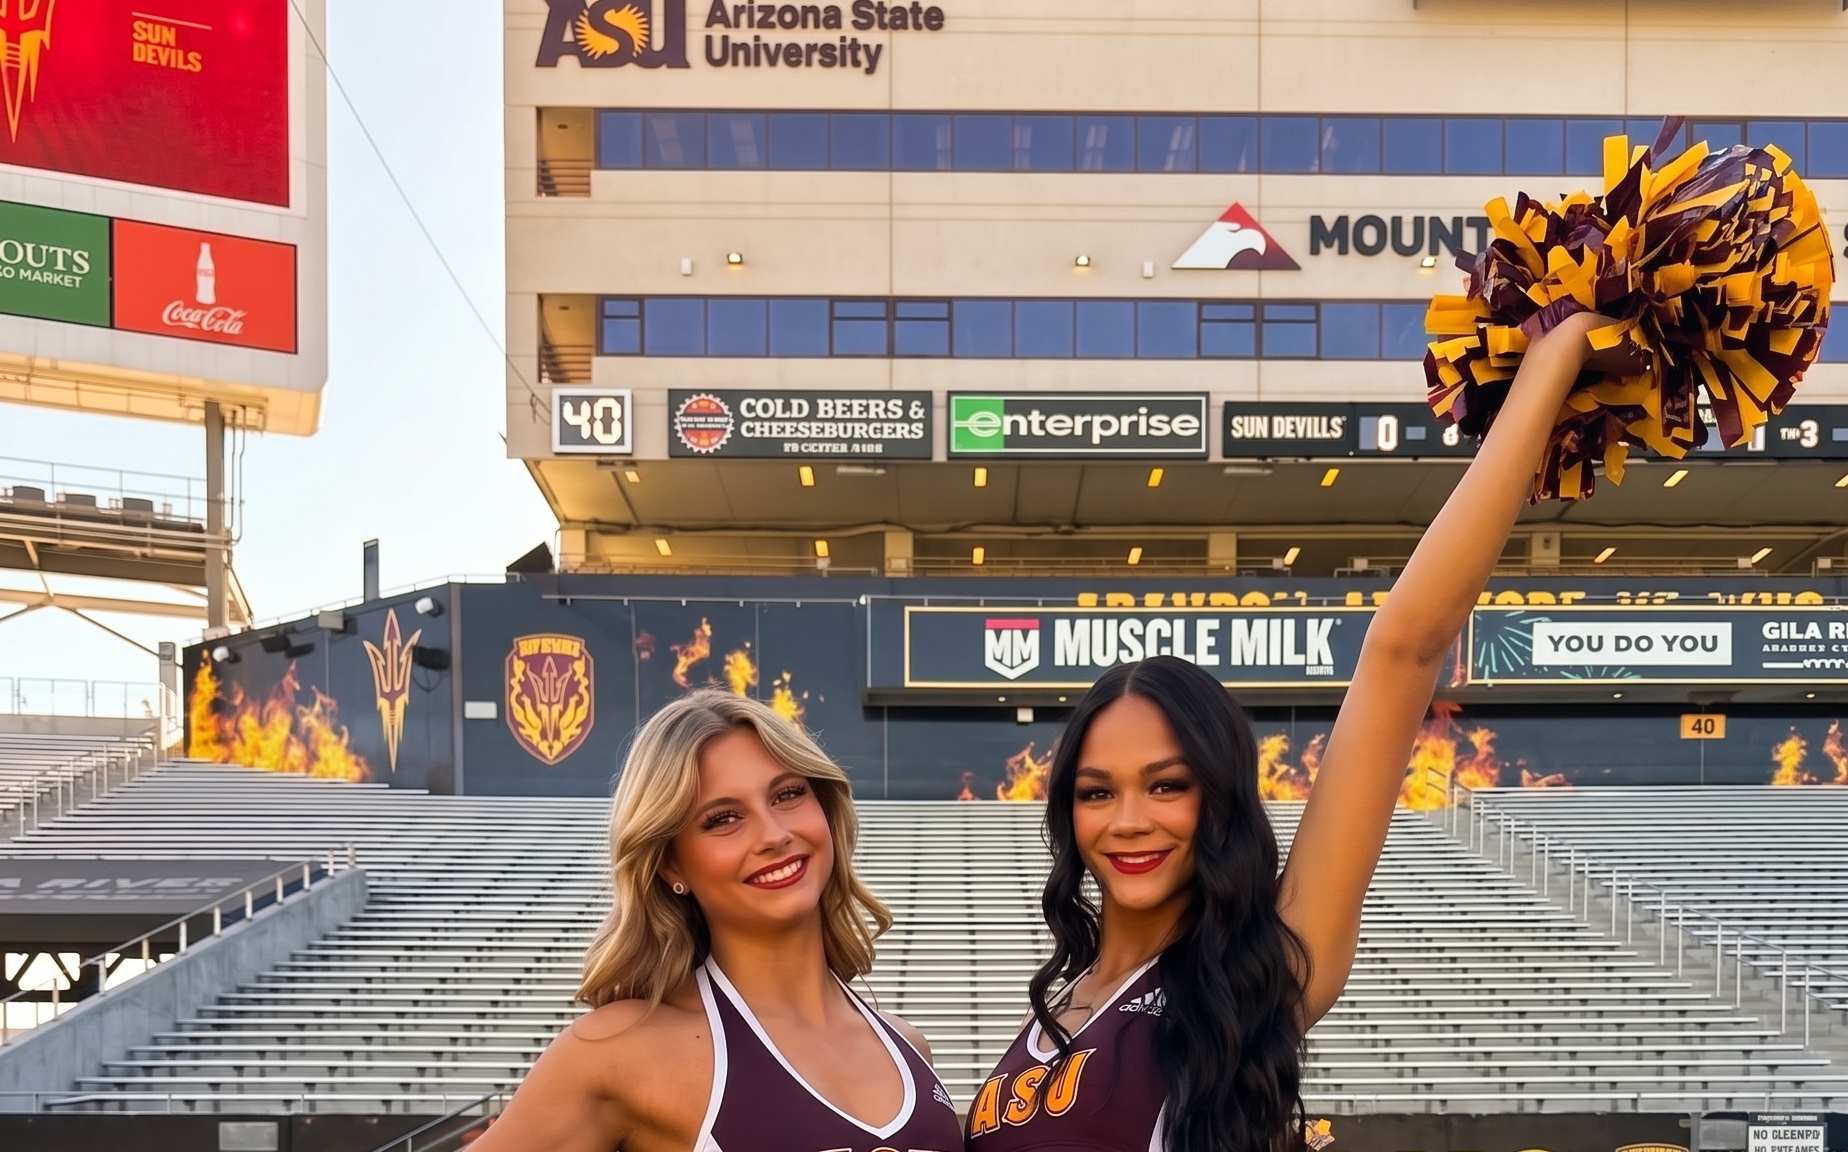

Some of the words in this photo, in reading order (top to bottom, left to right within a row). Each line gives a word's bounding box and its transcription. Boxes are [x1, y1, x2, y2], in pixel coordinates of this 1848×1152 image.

[705, 0, 842, 29] Arizona
[851, 0, 945, 31] State
[132, 20, 176, 47] SUN
[535, 0, 691, 69] ASU
[132, 43, 202, 72] DEVILS
[705, 35, 882, 74] University
[19, 268, 83, 288] MARKET
[562, 397, 622, 445] 40
[739, 398, 810, 419] COLD
[816, 398, 904, 420] BEERS
[908, 400, 926, 420] &
[740, 420, 925, 440] CHEESEBURGERS
[967, 406, 1201, 446] enterprise
[1231, 415, 1269, 439] SUN
[1054, 618, 1221, 667] MUSCLE
[1231, 618, 1335, 666] MILK
[1547, 634, 1604, 653] YOU
[1614, 634, 1655, 653] DO
[1662, 634, 1719, 653] YOU
[1761, 621, 1824, 640] GILA
[1691, 718, 1715, 735] 40
[970, 1047, 1098, 1140] ASU
[1753, 1129, 1769, 1140] NO
